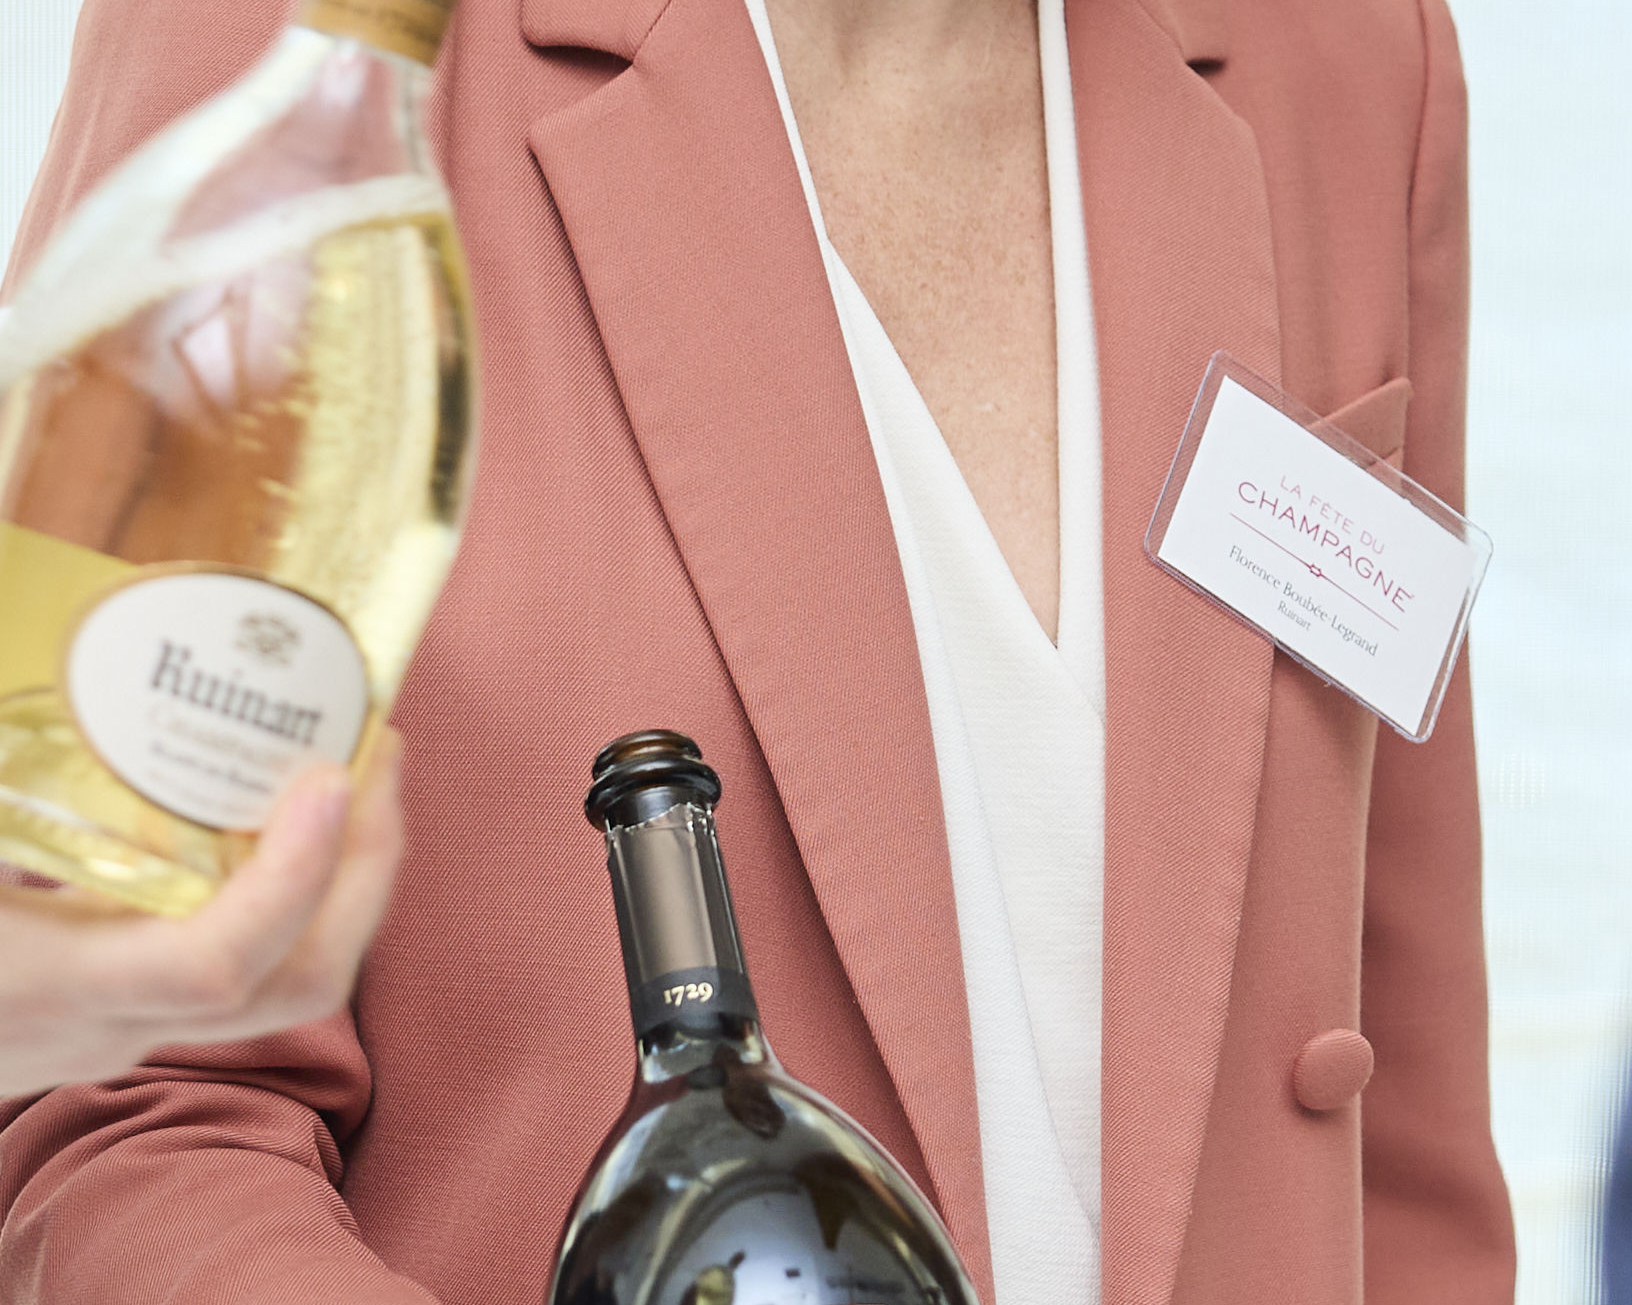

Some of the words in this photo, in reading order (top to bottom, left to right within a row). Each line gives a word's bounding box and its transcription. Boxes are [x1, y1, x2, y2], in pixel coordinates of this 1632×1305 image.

[1238, 481, 1411, 613] CHAMPAGNE
[1280, 475, 1302, 500] LA
[1309, 495, 1354, 535] FÊTE
[1360, 530, 1385, 555] DU
[1229, 545, 1281, 589] Florence
[1283, 581, 1379, 657] Boubée-Legrand
[1277, 600, 1312, 632] Ruinart
[149, 637, 323, 748] Ruinart
[663, 981, 715, 1008] 1729
